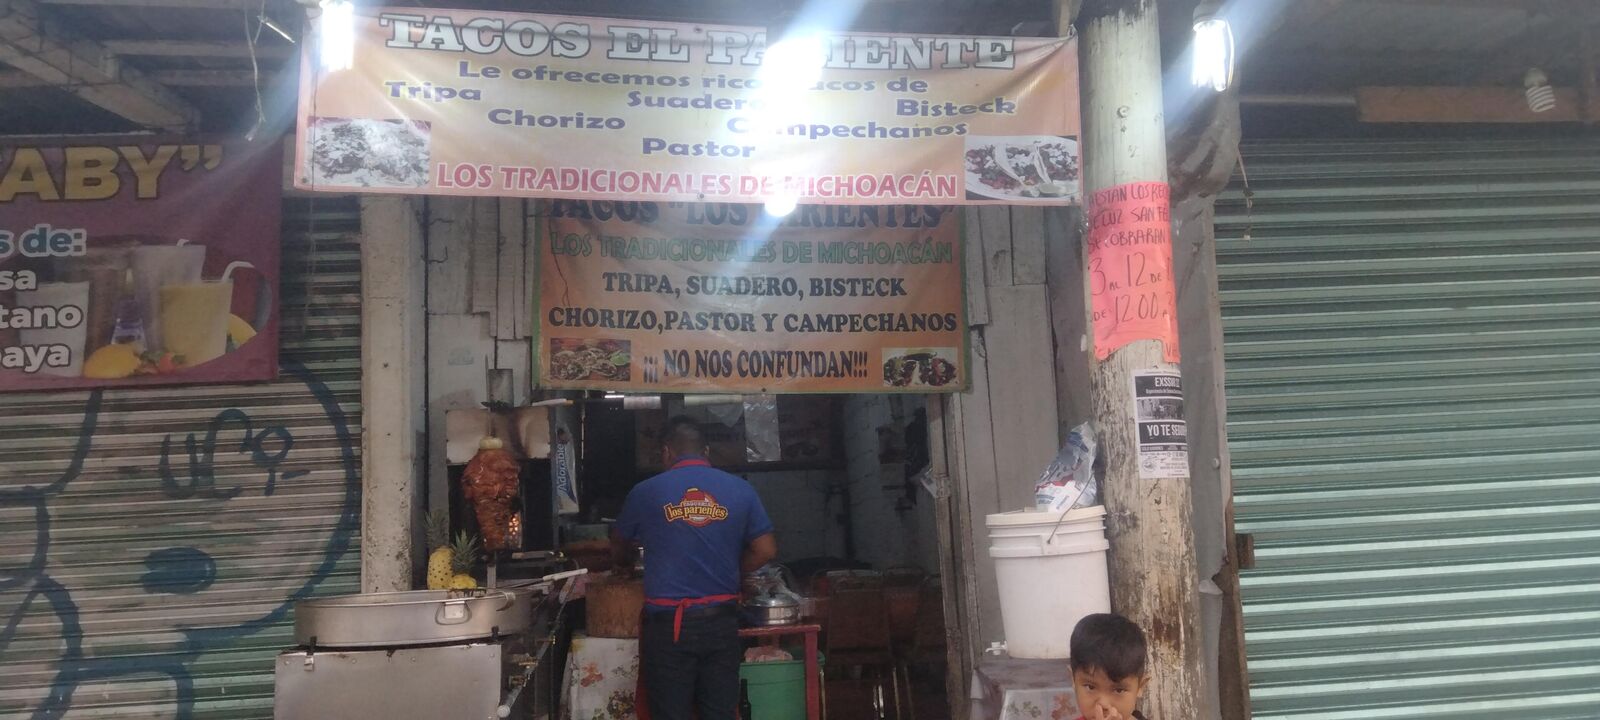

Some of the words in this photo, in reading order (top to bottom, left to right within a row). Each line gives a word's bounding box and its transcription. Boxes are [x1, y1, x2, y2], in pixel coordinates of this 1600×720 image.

[379, 12, 591, 58] TACOS
[607, 25, 690, 62] EL
[706, 29, 1016, 70] PAIENTE
[459, 61, 500, 78] Le
[512, 62, 691, 88] ofrecemos
[702, 75, 768, 91] rico
[802, 76, 876, 92] acos
[886, 76, 928, 93] de
[385, 81, 482, 102] Tripa
[896, 98, 1016, 117] Bisteck
[488, 109, 626, 131] Chorizo
[727, 116, 968, 140] Cmpechanos
[642, 138, 757, 159] Pastor
[438, 164, 492, 189] LOS
[500, 167, 731, 197] TRADICIONALES
[739, 175, 773, 197] DE
[784, 170, 957, 198] MICHOACÁN
[20, 224, 87, 257] de:
[550, 232, 594, 258] LOS
[600, 235, 777, 264] TRADICIONALES
[782, 240, 814, 262] DE
[818, 237, 953, 265] MICHOACÁN
[602, 271, 680, 299] TRIPA,
[686, 274, 804, 300] SUADERO,
[809, 276, 907, 298] BISTECK
[1126, 252, 1147, 289] 12
[761, 313, 780, 332] Y
[784, 311, 958, 333] CAMPECHANOS
[663, 349, 690, 377] NO
[695, 349, 733, 378] NOS
[736, 349, 869, 379] CONFUNDAN!!!
[556, 443, 568, 492] Adorable
[668, 503, 683, 519] los
